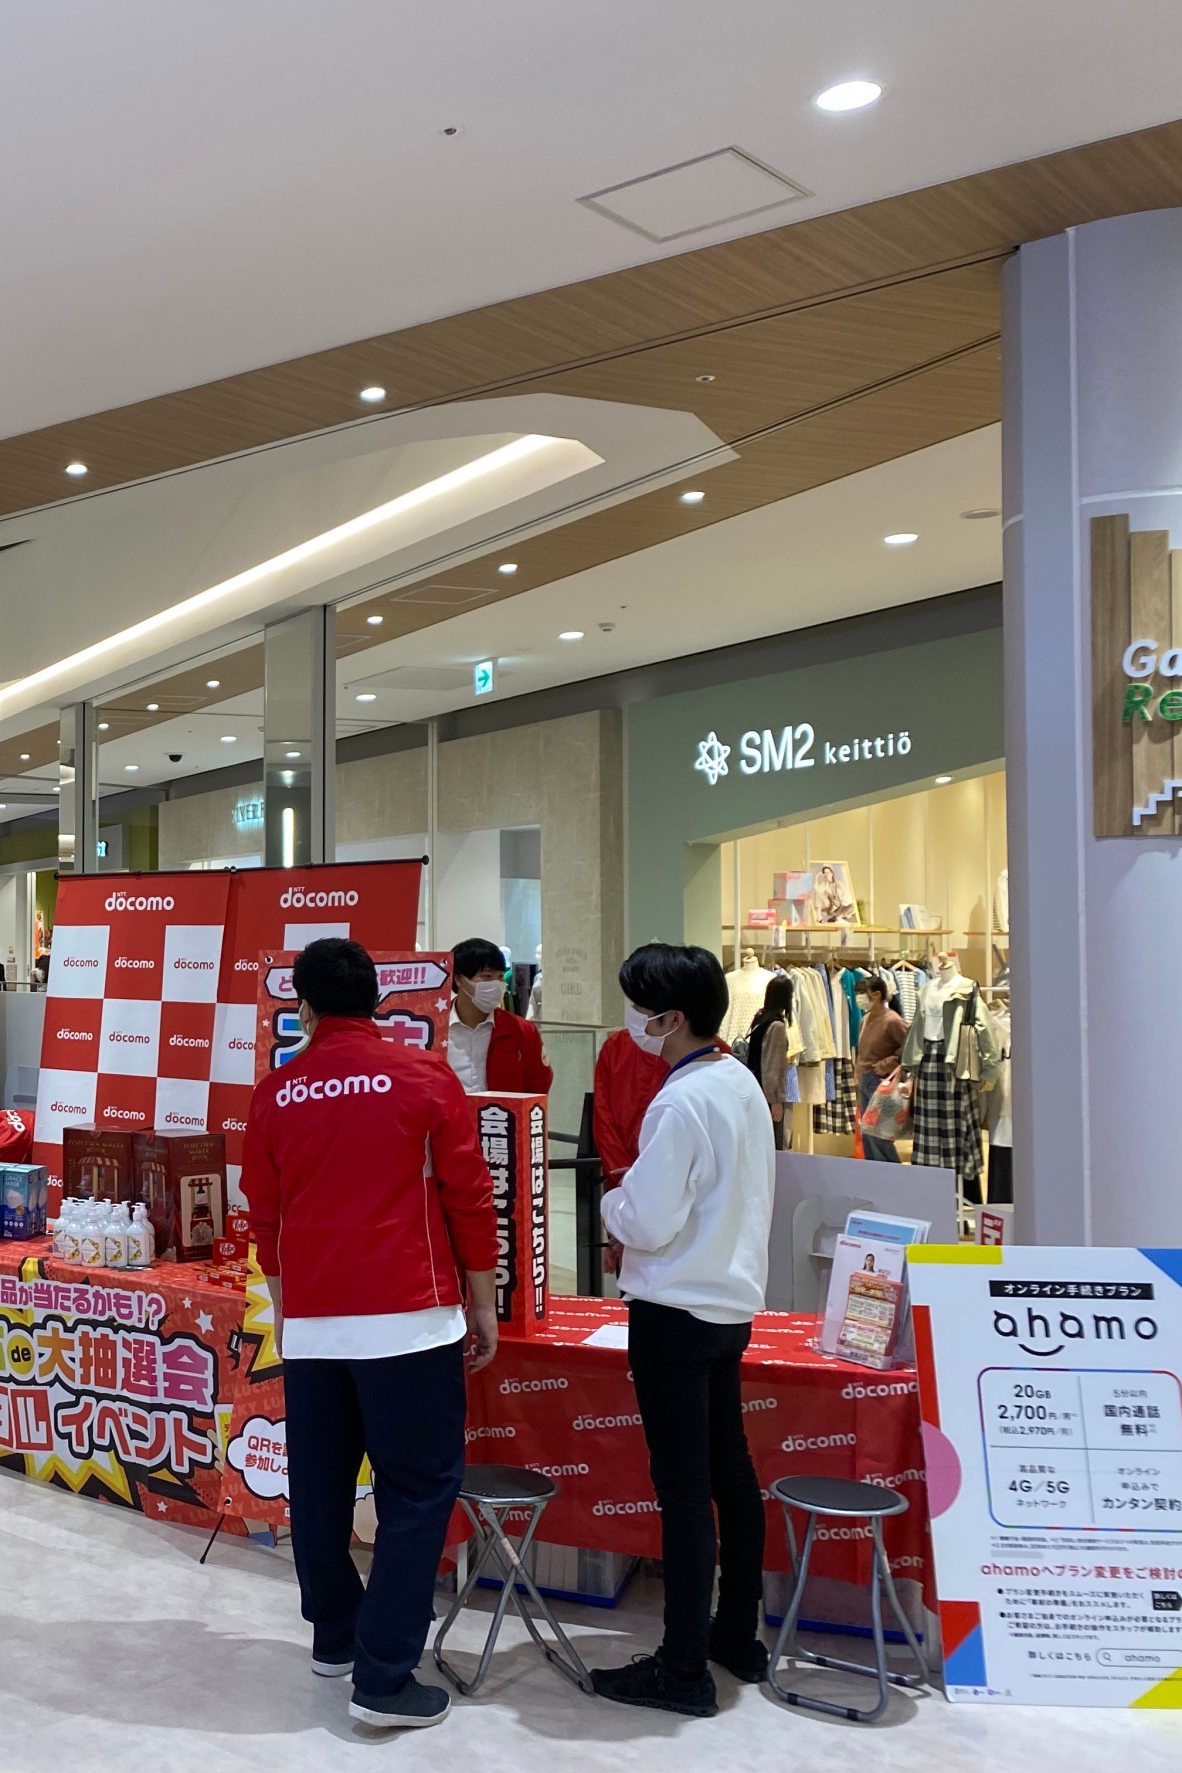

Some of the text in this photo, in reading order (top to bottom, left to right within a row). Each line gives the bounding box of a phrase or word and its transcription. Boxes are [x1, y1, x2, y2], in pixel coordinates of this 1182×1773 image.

[1122, 639, 1182, 679] Ga
[1121, 683, 1182, 723] Re
[740, 722, 912, 775] SM2 keittiö
[105, 892, 174, 911] docomo
[280, 887, 359, 909] docomo
[63, 957, 99, 968] docomo
[114, 957, 154, 969] docomo
[174, 958, 215, 970] docomo
[234, 959, 258, 971] doco
[56, 1028, 93, 1041] docomo
[109, 1031, 150, 1044] docomo
[169, 1035, 209, 1048] docomo
[228, 1038, 254, 1051] doco
[276, 1074, 392, 1108] docomo
[50, 1101, 87, 1115] docomo
[103, 1106, 146, 1121] docomo
[165, 1112, 204, 1126] docomo
[1003, 1283, 1142, 1297] オンライン手続きプラン
[993, 1307, 1159, 1340] ahamo
[499, 1378, 568, 1395] docomo
[842, 1382, 918, 1400] docomo
[1013, 1384, 1052, 1399] 20GB
[1104, 1405, 1161, 1419] 国内通話
[572, 1413, 643, 1431] docomo
[781, 1433, 857, 1452] docomo
[1118, 1467, 1160, 1476] オンライン
[1017, 1499, 1067, 1509] ネットワーク
[1124, 1654, 1161, 1663] ahamo
